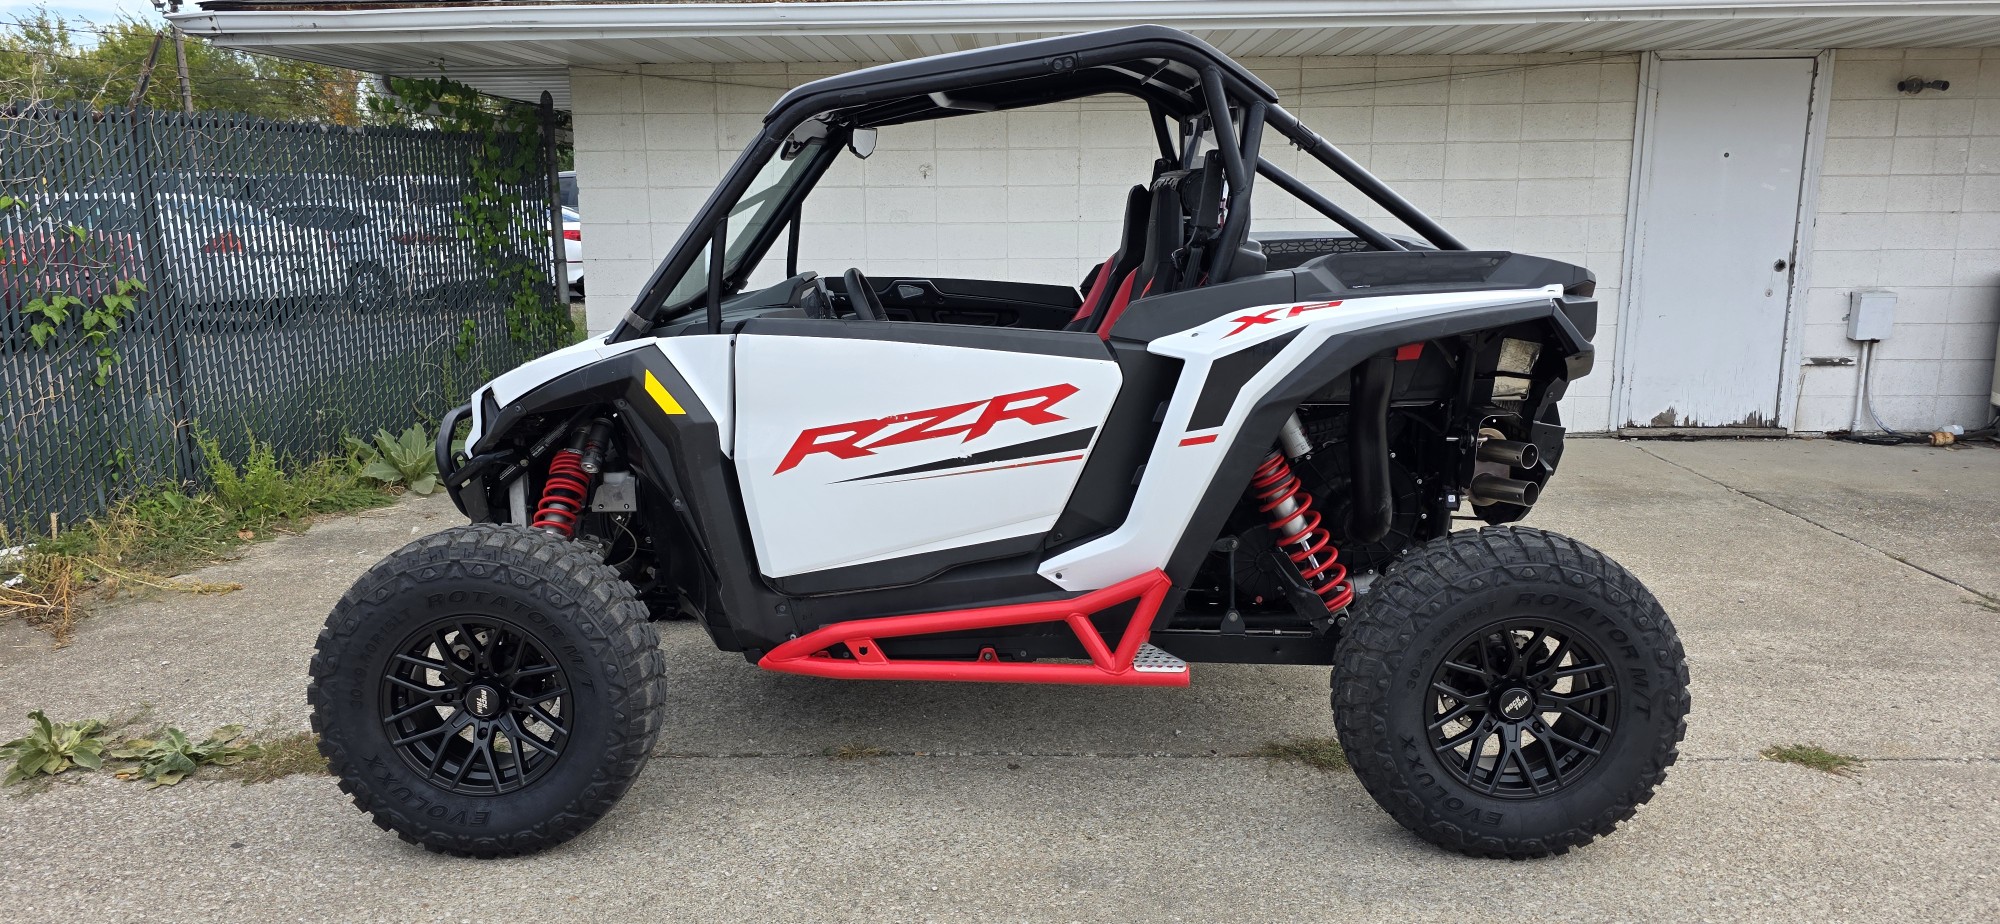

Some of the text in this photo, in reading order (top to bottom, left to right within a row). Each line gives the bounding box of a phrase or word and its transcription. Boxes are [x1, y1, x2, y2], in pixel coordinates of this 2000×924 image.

[1219, 300, 1343, 340] XP
[772, 383, 1080, 476] RZR
[426, 590, 598, 696] ROTATOR M/T
[1513, 591, 1652, 721] ROTATOR M/T
[1504, 695, 1521, 713] ROCK
[361, 753, 492, 828] EVOLUXX
[1398, 734, 1504, 828] EVOLUXX
